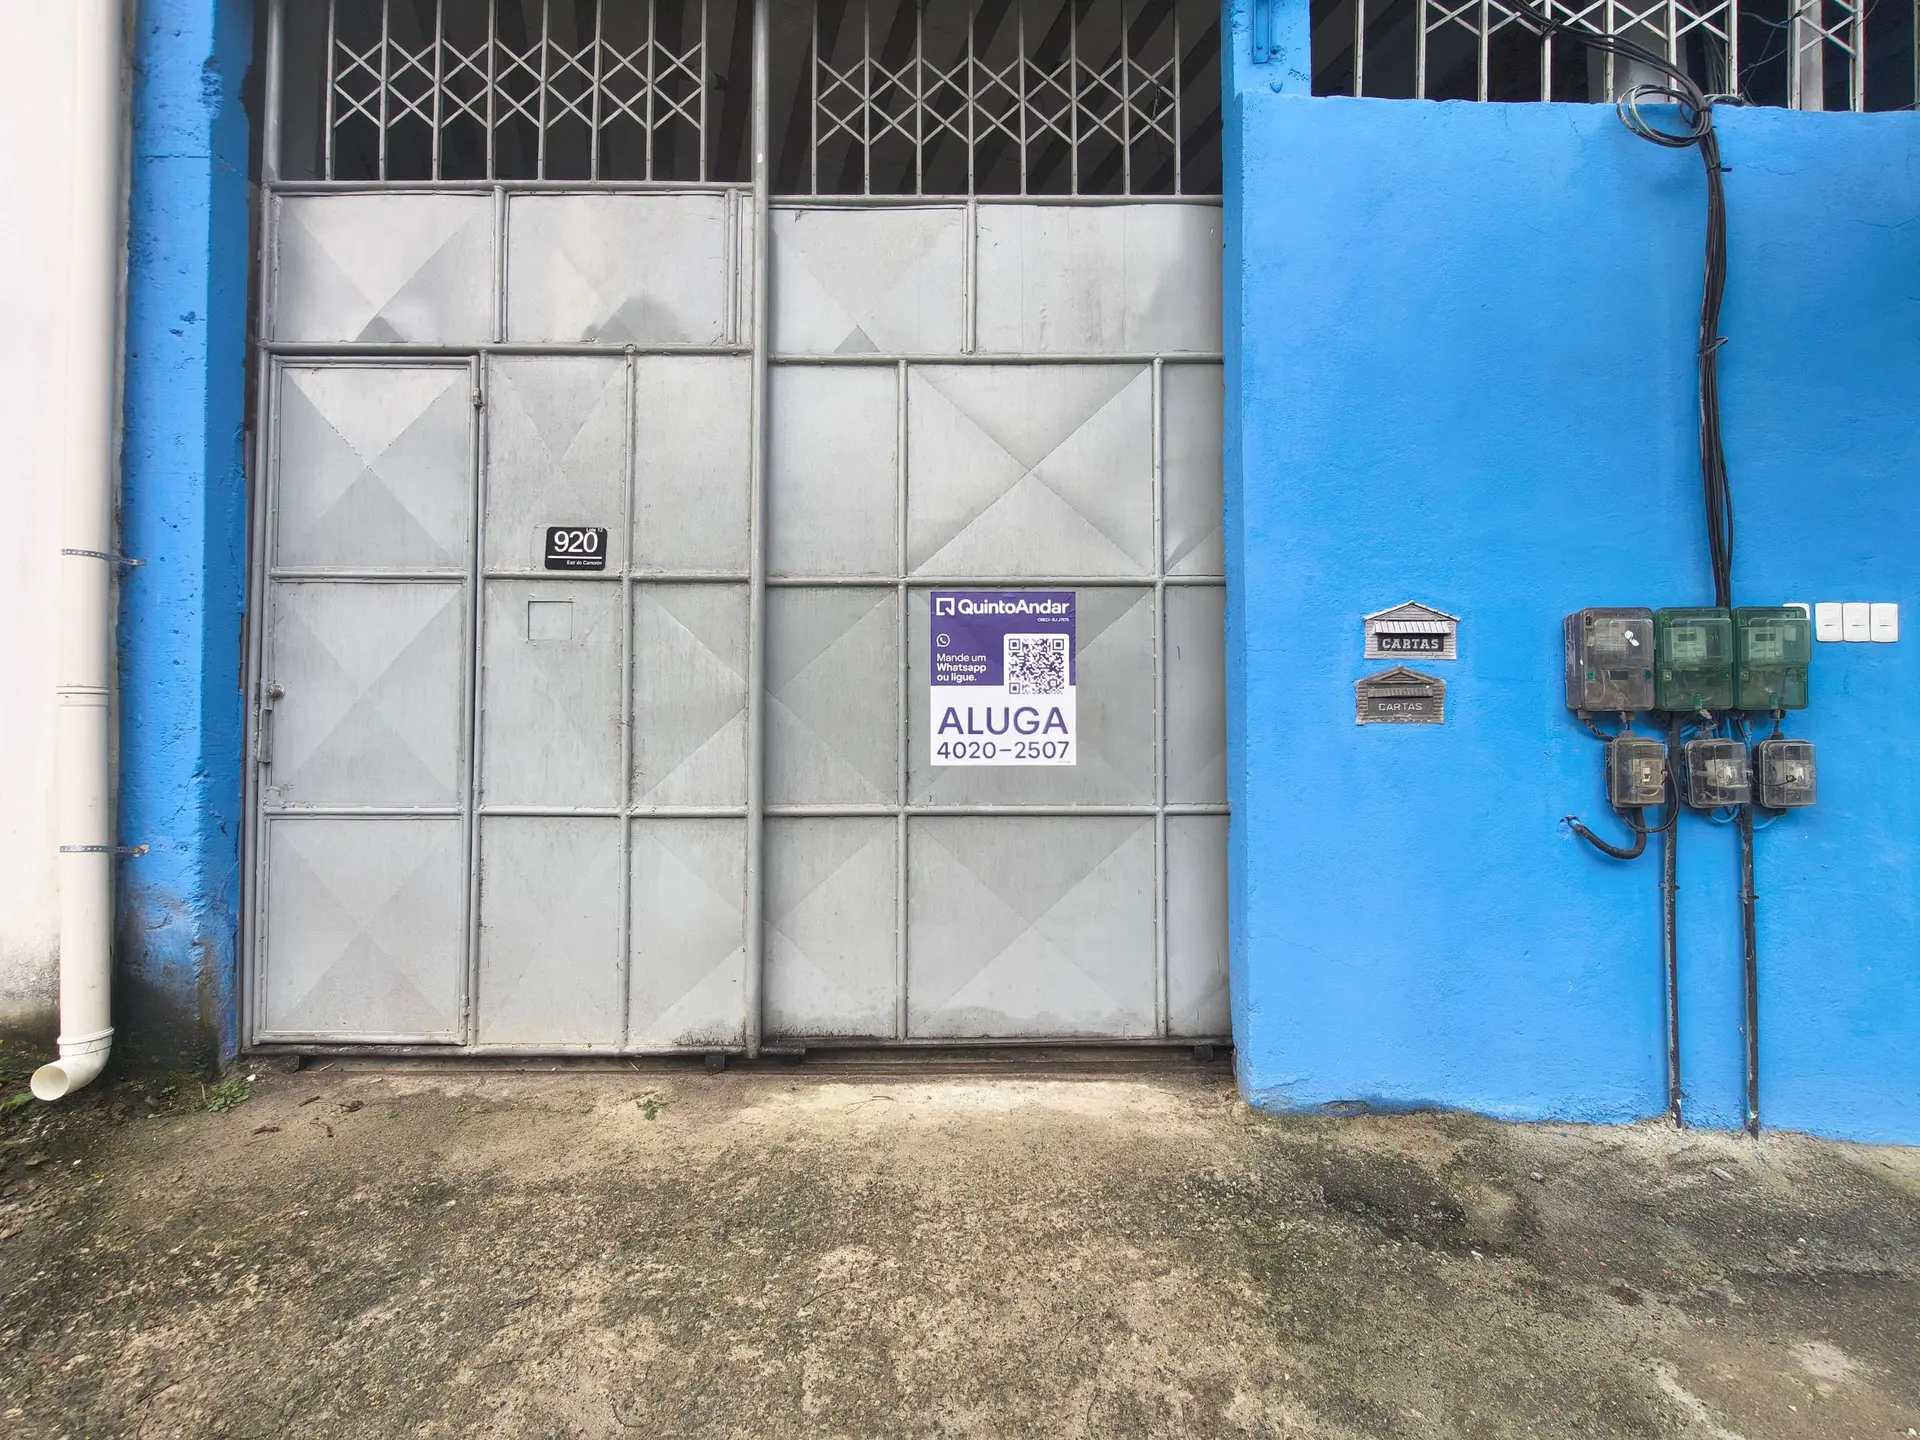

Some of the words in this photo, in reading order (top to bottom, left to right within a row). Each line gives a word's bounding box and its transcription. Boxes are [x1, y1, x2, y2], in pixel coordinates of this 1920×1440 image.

[554, 530, 598, 553] 920
[957, 598, 1070, 615] QuintoAndar
[1382, 638, 1439, 649] CARTAS
[936, 653, 970, 662] Mande
[936, 663, 987, 673] Whatsapp
[951, 673, 977, 683] ligue.
[1378, 702, 1423, 711] CARTAS
[937, 706, 1069, 735] ALUGA
[936, 741, 1070, 759] 4020-2507
